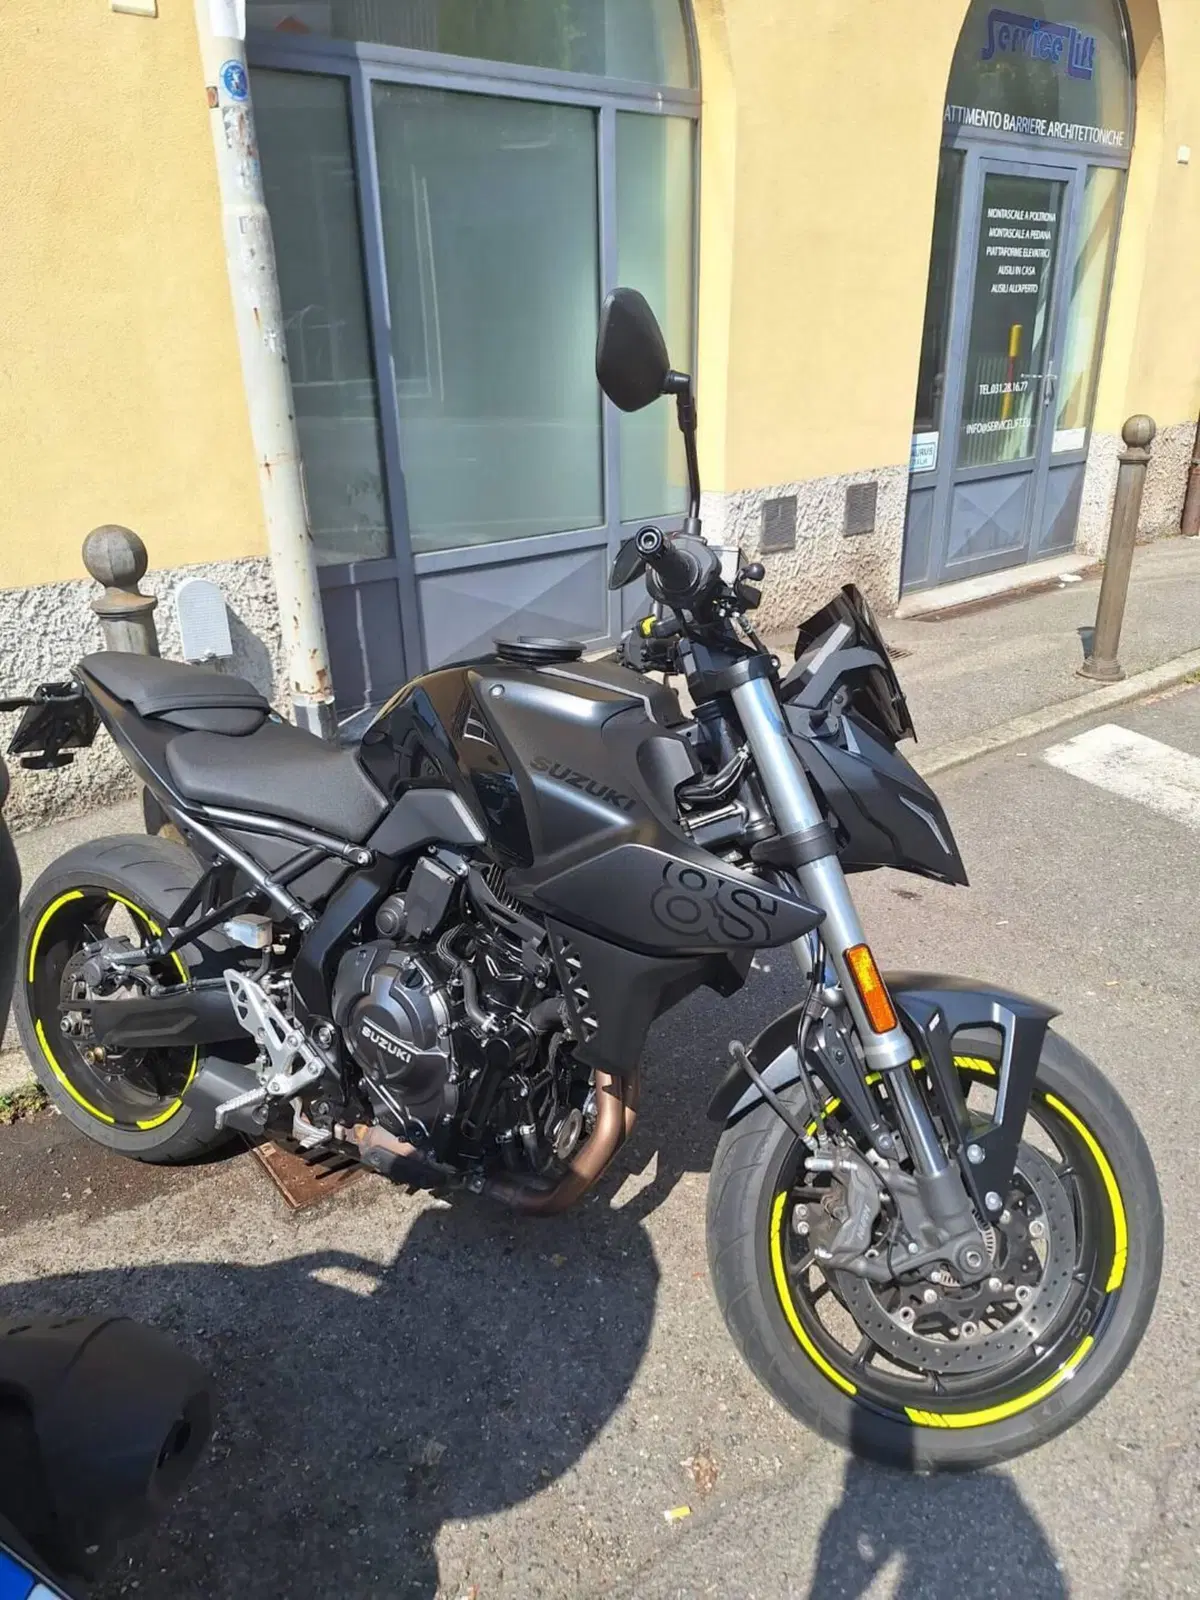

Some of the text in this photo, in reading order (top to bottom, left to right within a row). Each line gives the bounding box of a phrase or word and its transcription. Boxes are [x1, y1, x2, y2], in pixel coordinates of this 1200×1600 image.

[1003, 113, 1047, 136] BARRIERE
[1047, 121, 1125, 147] ARCHITETTONICHE
[987, 208, 1056, 222] MONTASCALE A POLTRONA
[988, 227, 1051, 240] MONTASCALE A PEDANA
[986, 246, 1022, 257] PIATTAFORME
[1015, 266, 1021, 275] IN
[1022, 266, 1036, 276] CASA
[530, 755, 636, 812] SUZUKI
[361, 1025, 412, 1064] SUZUKI
